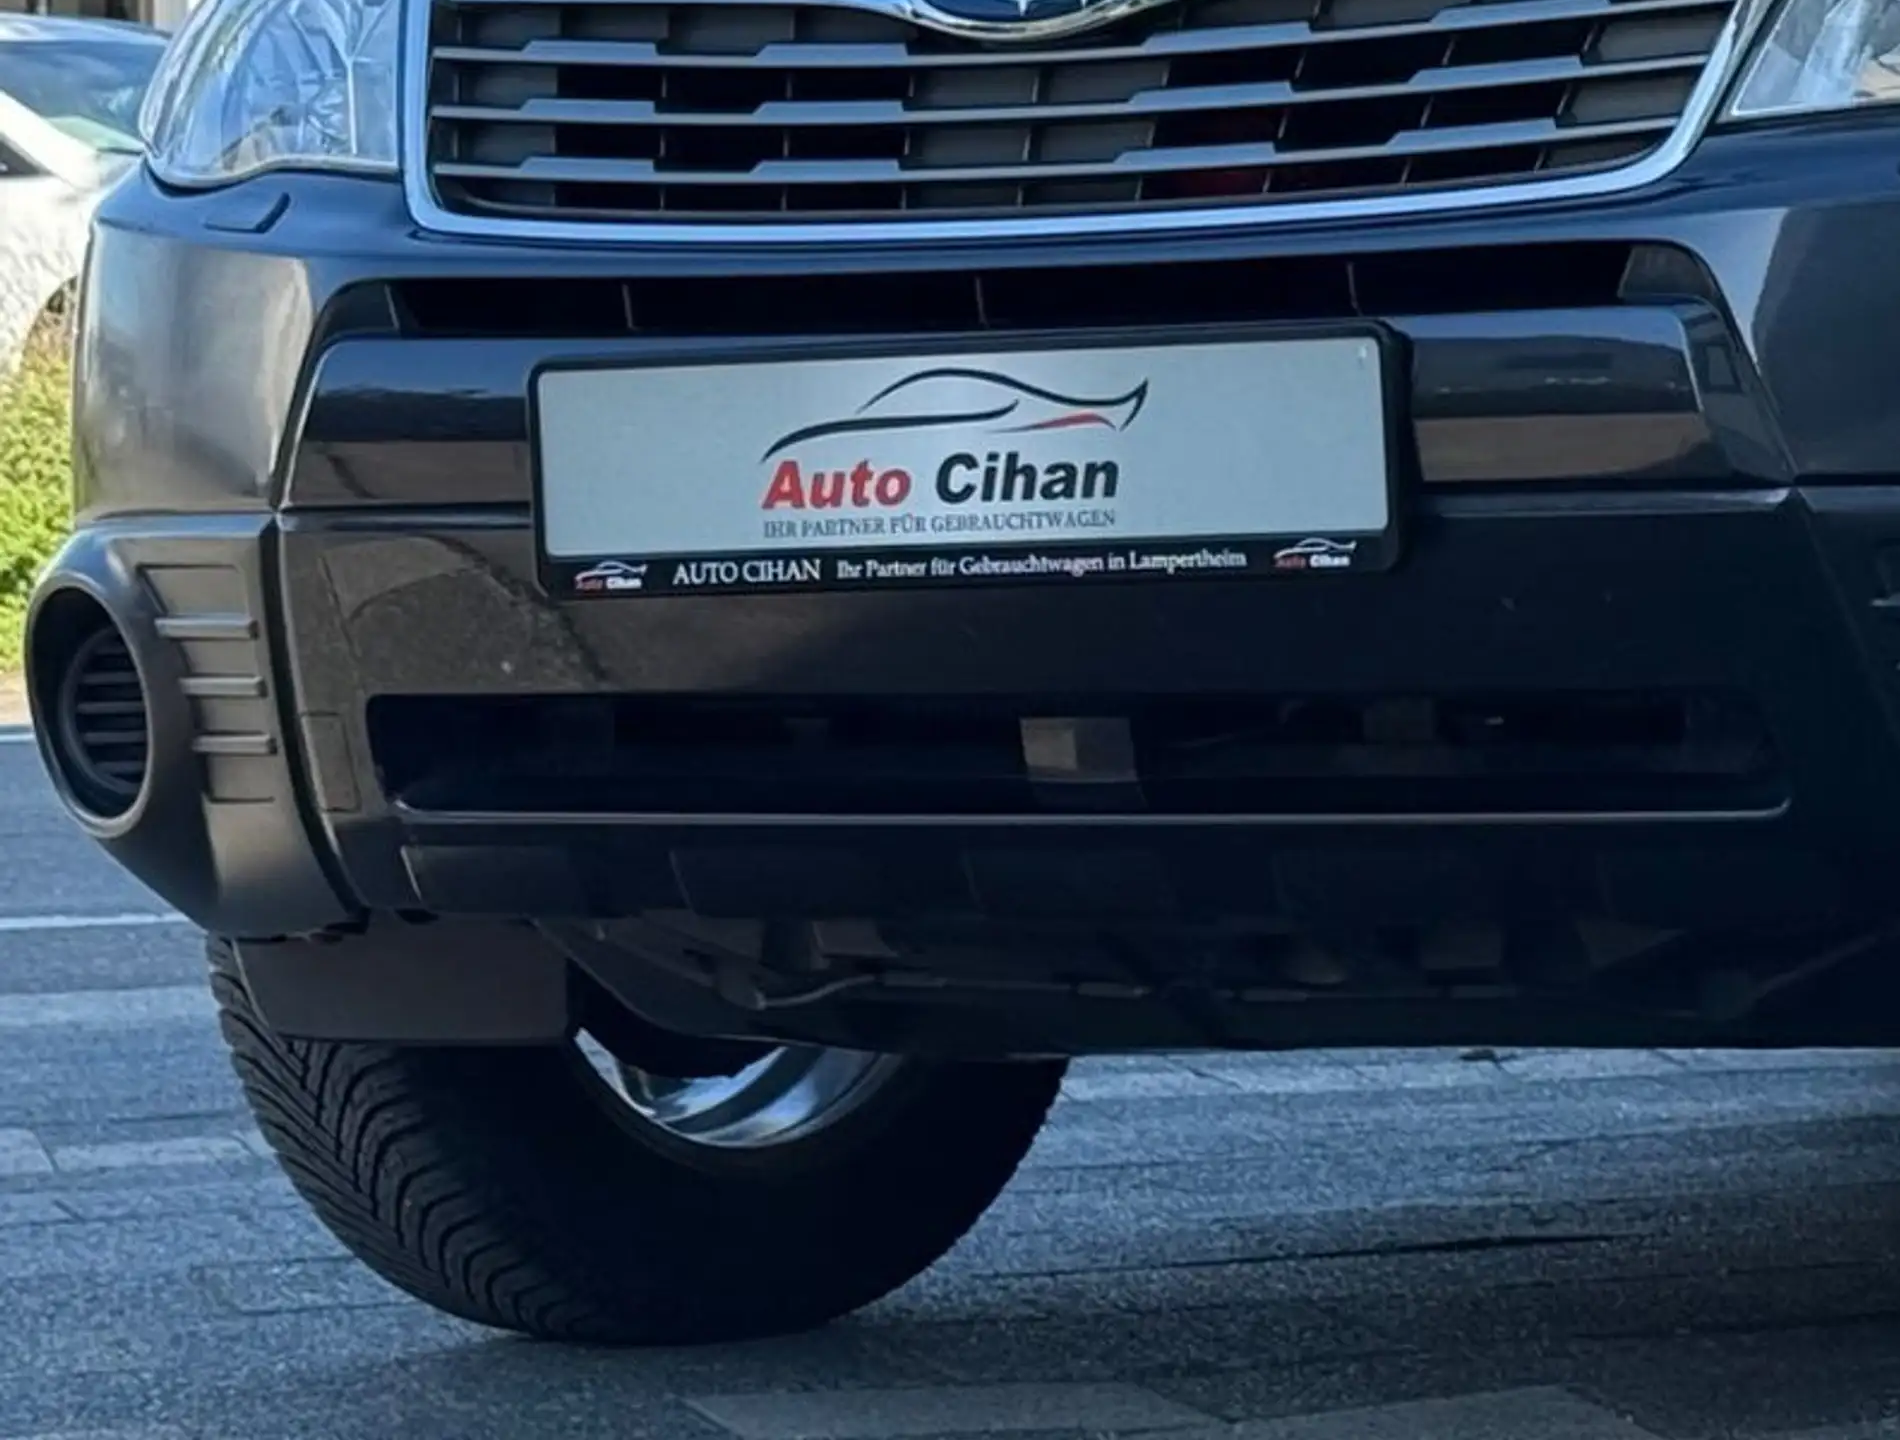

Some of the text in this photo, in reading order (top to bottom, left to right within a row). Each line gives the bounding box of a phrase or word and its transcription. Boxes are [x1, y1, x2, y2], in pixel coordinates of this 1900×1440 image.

[761, 452, 1119, 510] Auto Cihan
[763, 509, 1116, 539] IHR PARTNER FÜR GEBRAUCHTWAGEN
[672, 548, 1248, 586] AUTO CIHAN Ihr Partner für Gebrauchtwagen in Lampertheim
